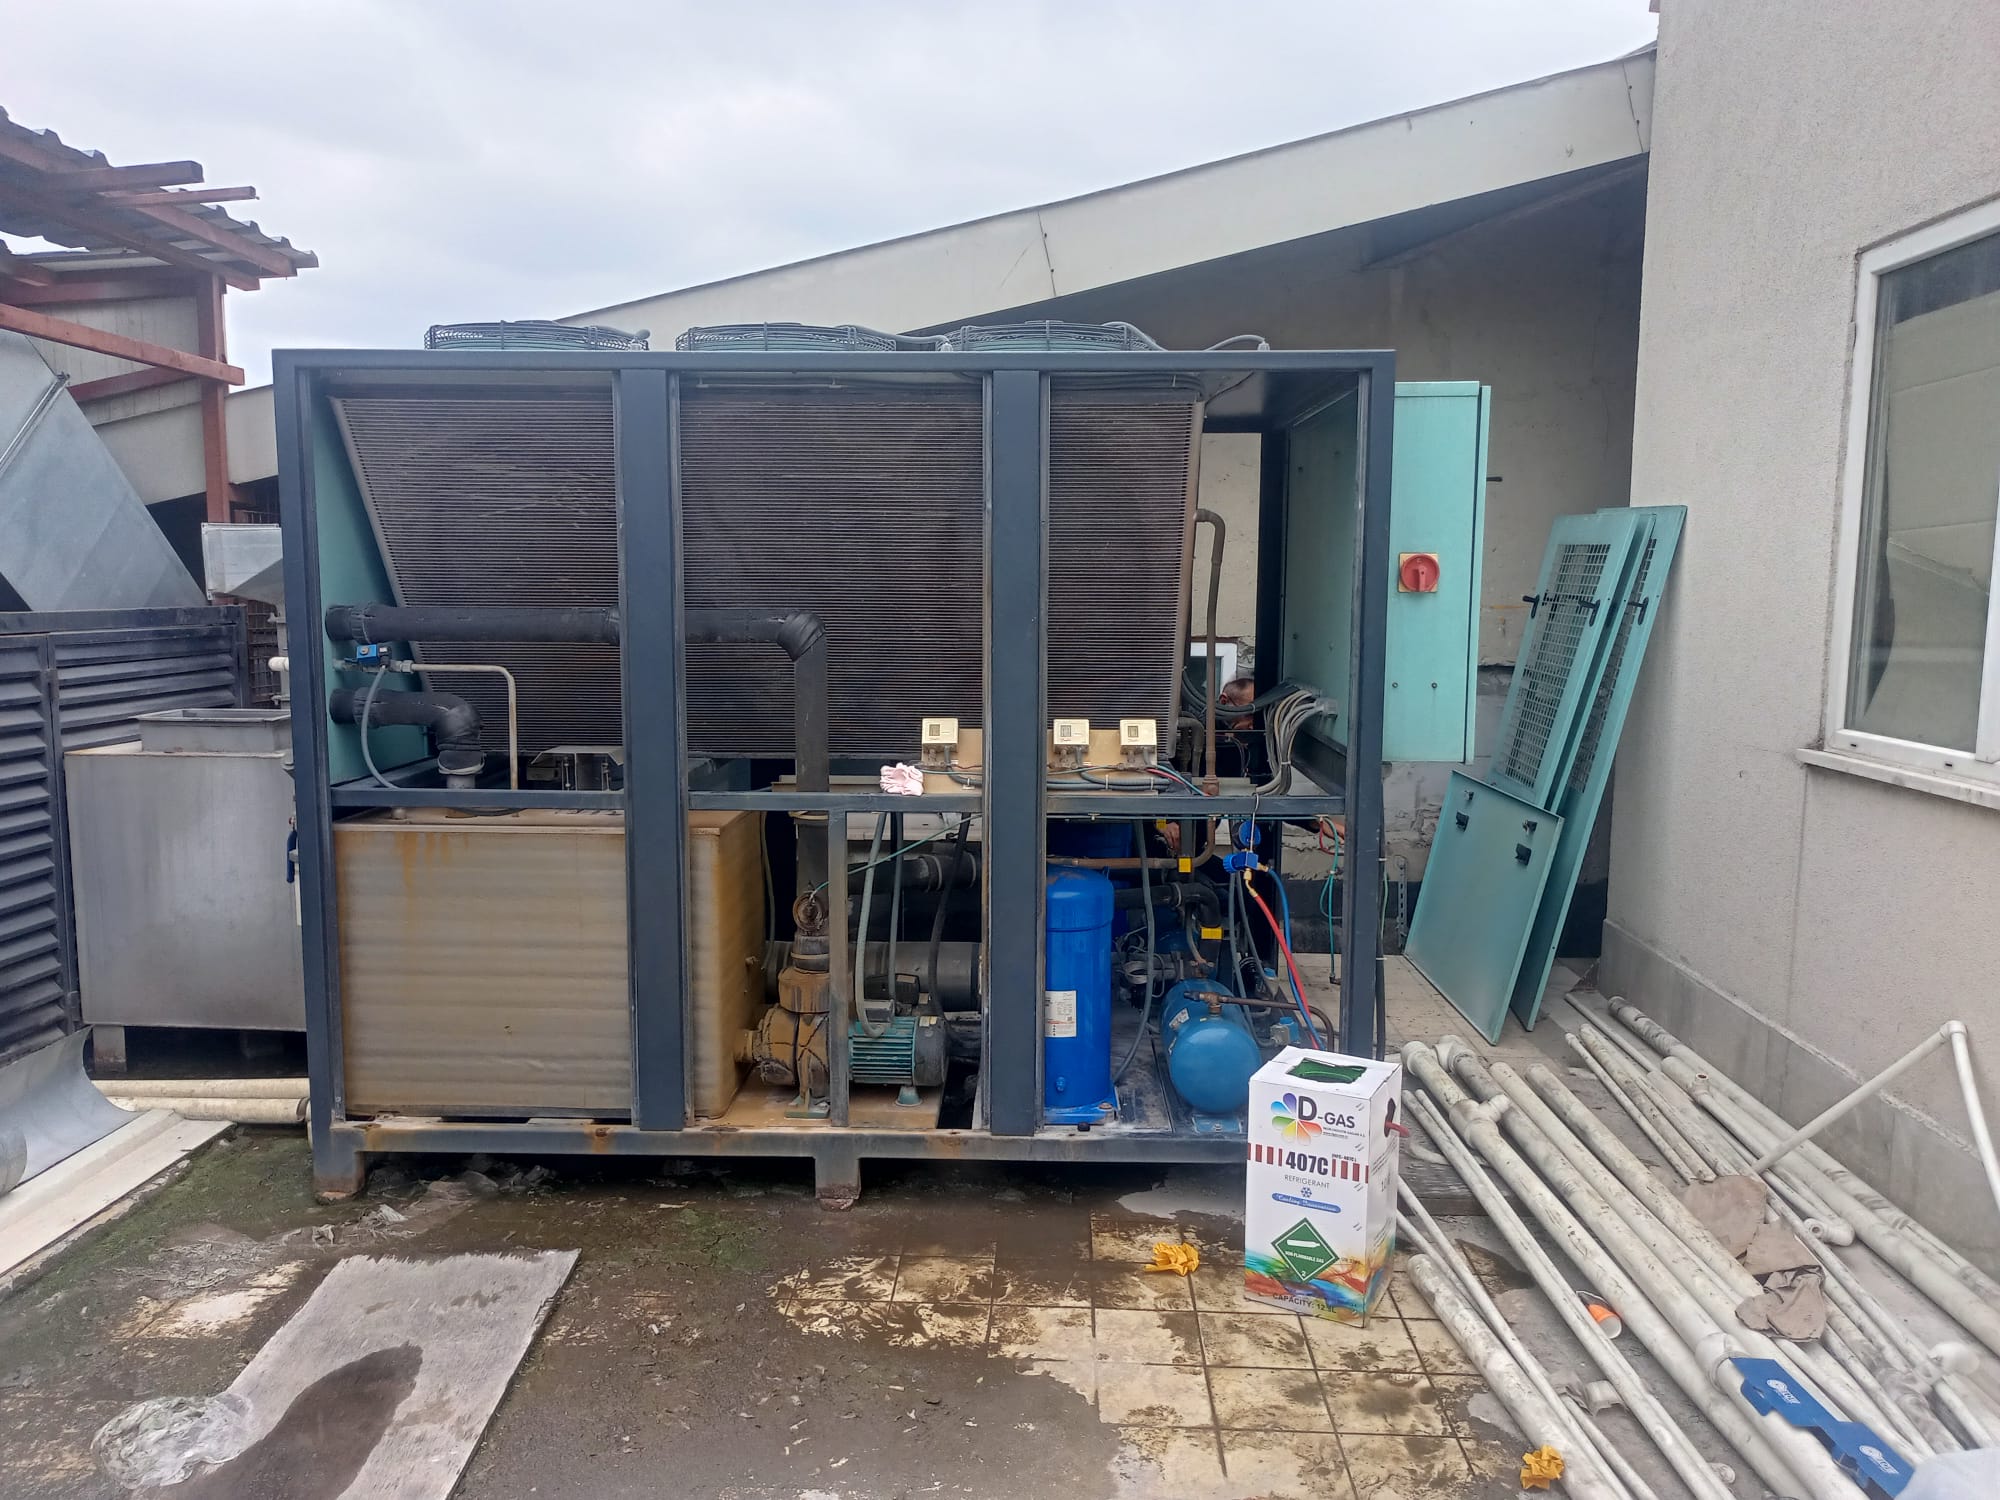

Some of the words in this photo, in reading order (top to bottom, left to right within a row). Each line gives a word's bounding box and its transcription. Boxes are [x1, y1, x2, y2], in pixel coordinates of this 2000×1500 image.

[1298, 1096, 1355, 1128] D-GAS
[1285, 1151, 1329, 1175] 407C
[1284, 1174, 1330, 1189] REFRIGERANT
[1272, 1292, 1315, 1309] CAPACITY:
